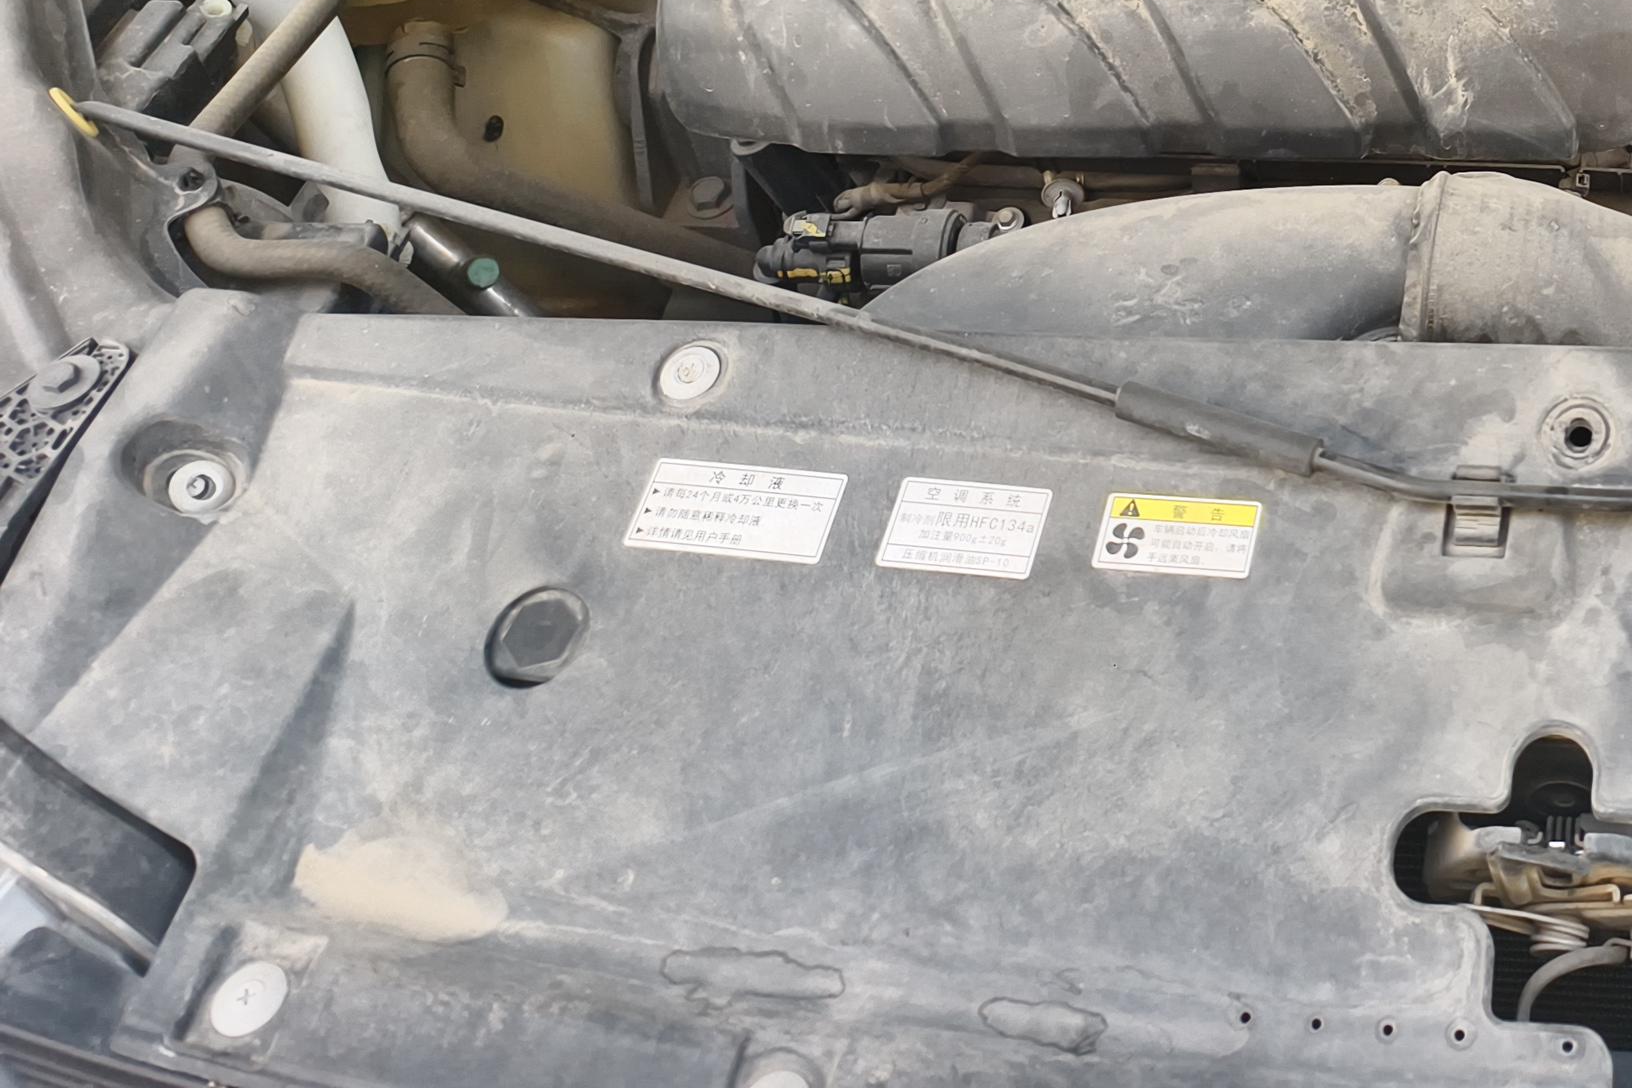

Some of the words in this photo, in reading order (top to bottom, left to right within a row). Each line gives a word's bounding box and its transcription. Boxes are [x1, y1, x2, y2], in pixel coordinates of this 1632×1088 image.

[708, 470, 786, 491] 冷却液
[924, 486, 1023, 509] 空调系统
[1172, 504, 1224, 522] 警告
